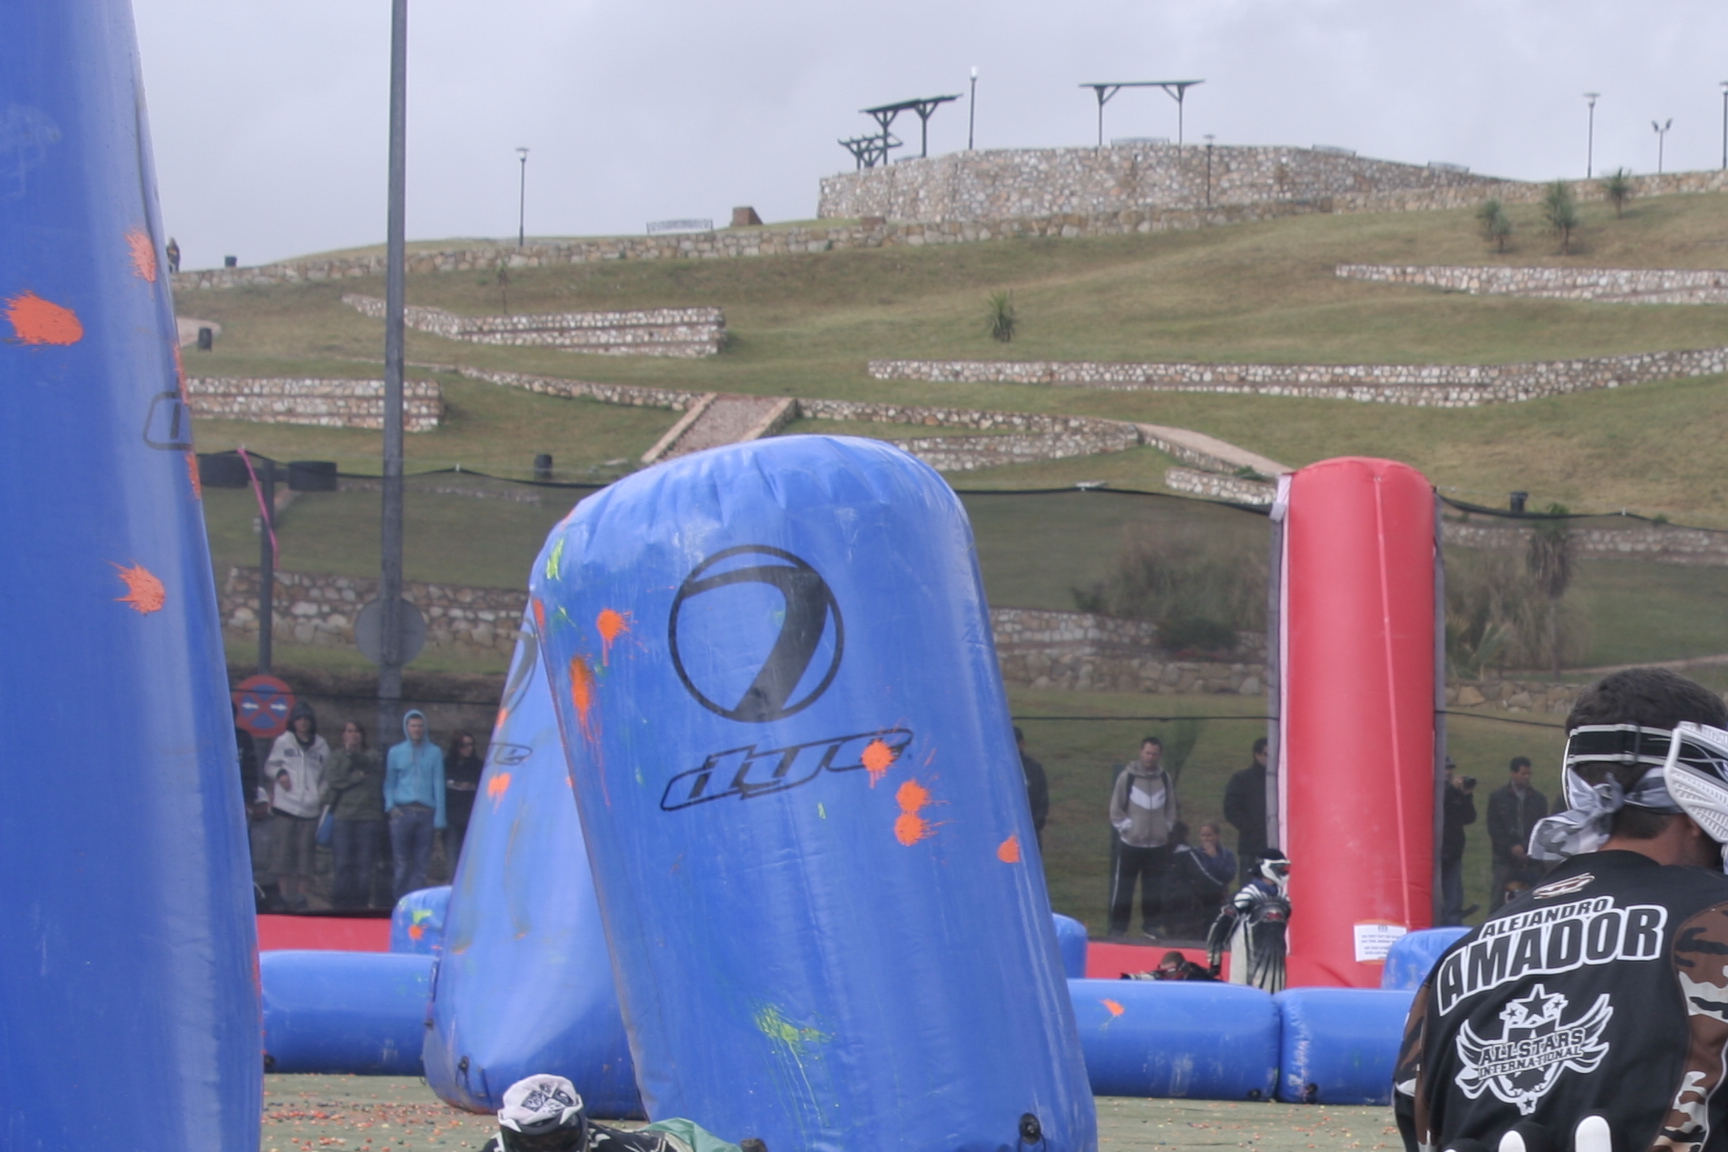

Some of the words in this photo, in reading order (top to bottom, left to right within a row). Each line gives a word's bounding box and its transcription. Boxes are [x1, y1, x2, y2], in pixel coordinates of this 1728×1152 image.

[1479, 896, 1614, 941] ALEJANDRO
[1438, 905, 1668, 1015] AMADOR
[1479, 1047, 1583, 1079] INTERNATIONAL
